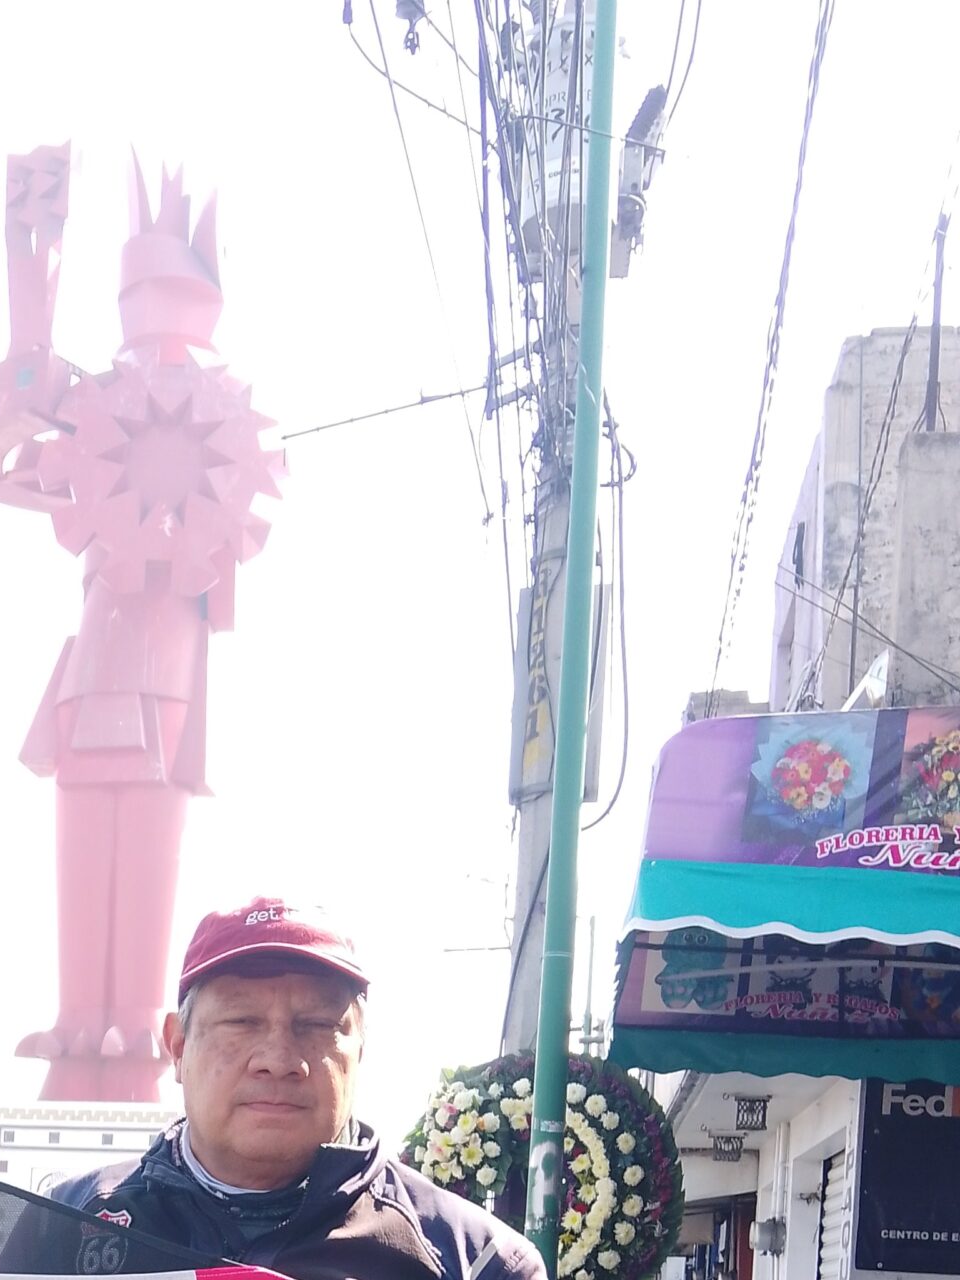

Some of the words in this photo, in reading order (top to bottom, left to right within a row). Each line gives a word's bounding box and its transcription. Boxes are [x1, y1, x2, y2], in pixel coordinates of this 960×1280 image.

[817, 825, 941, 857] FLORERIA
[245, 907, 280, 925] get
[828, 992, 902, 1020] RGALOS
[881, 1229, 929, 1241] CENTRO
[932, 1231, 948, 1242] DE
